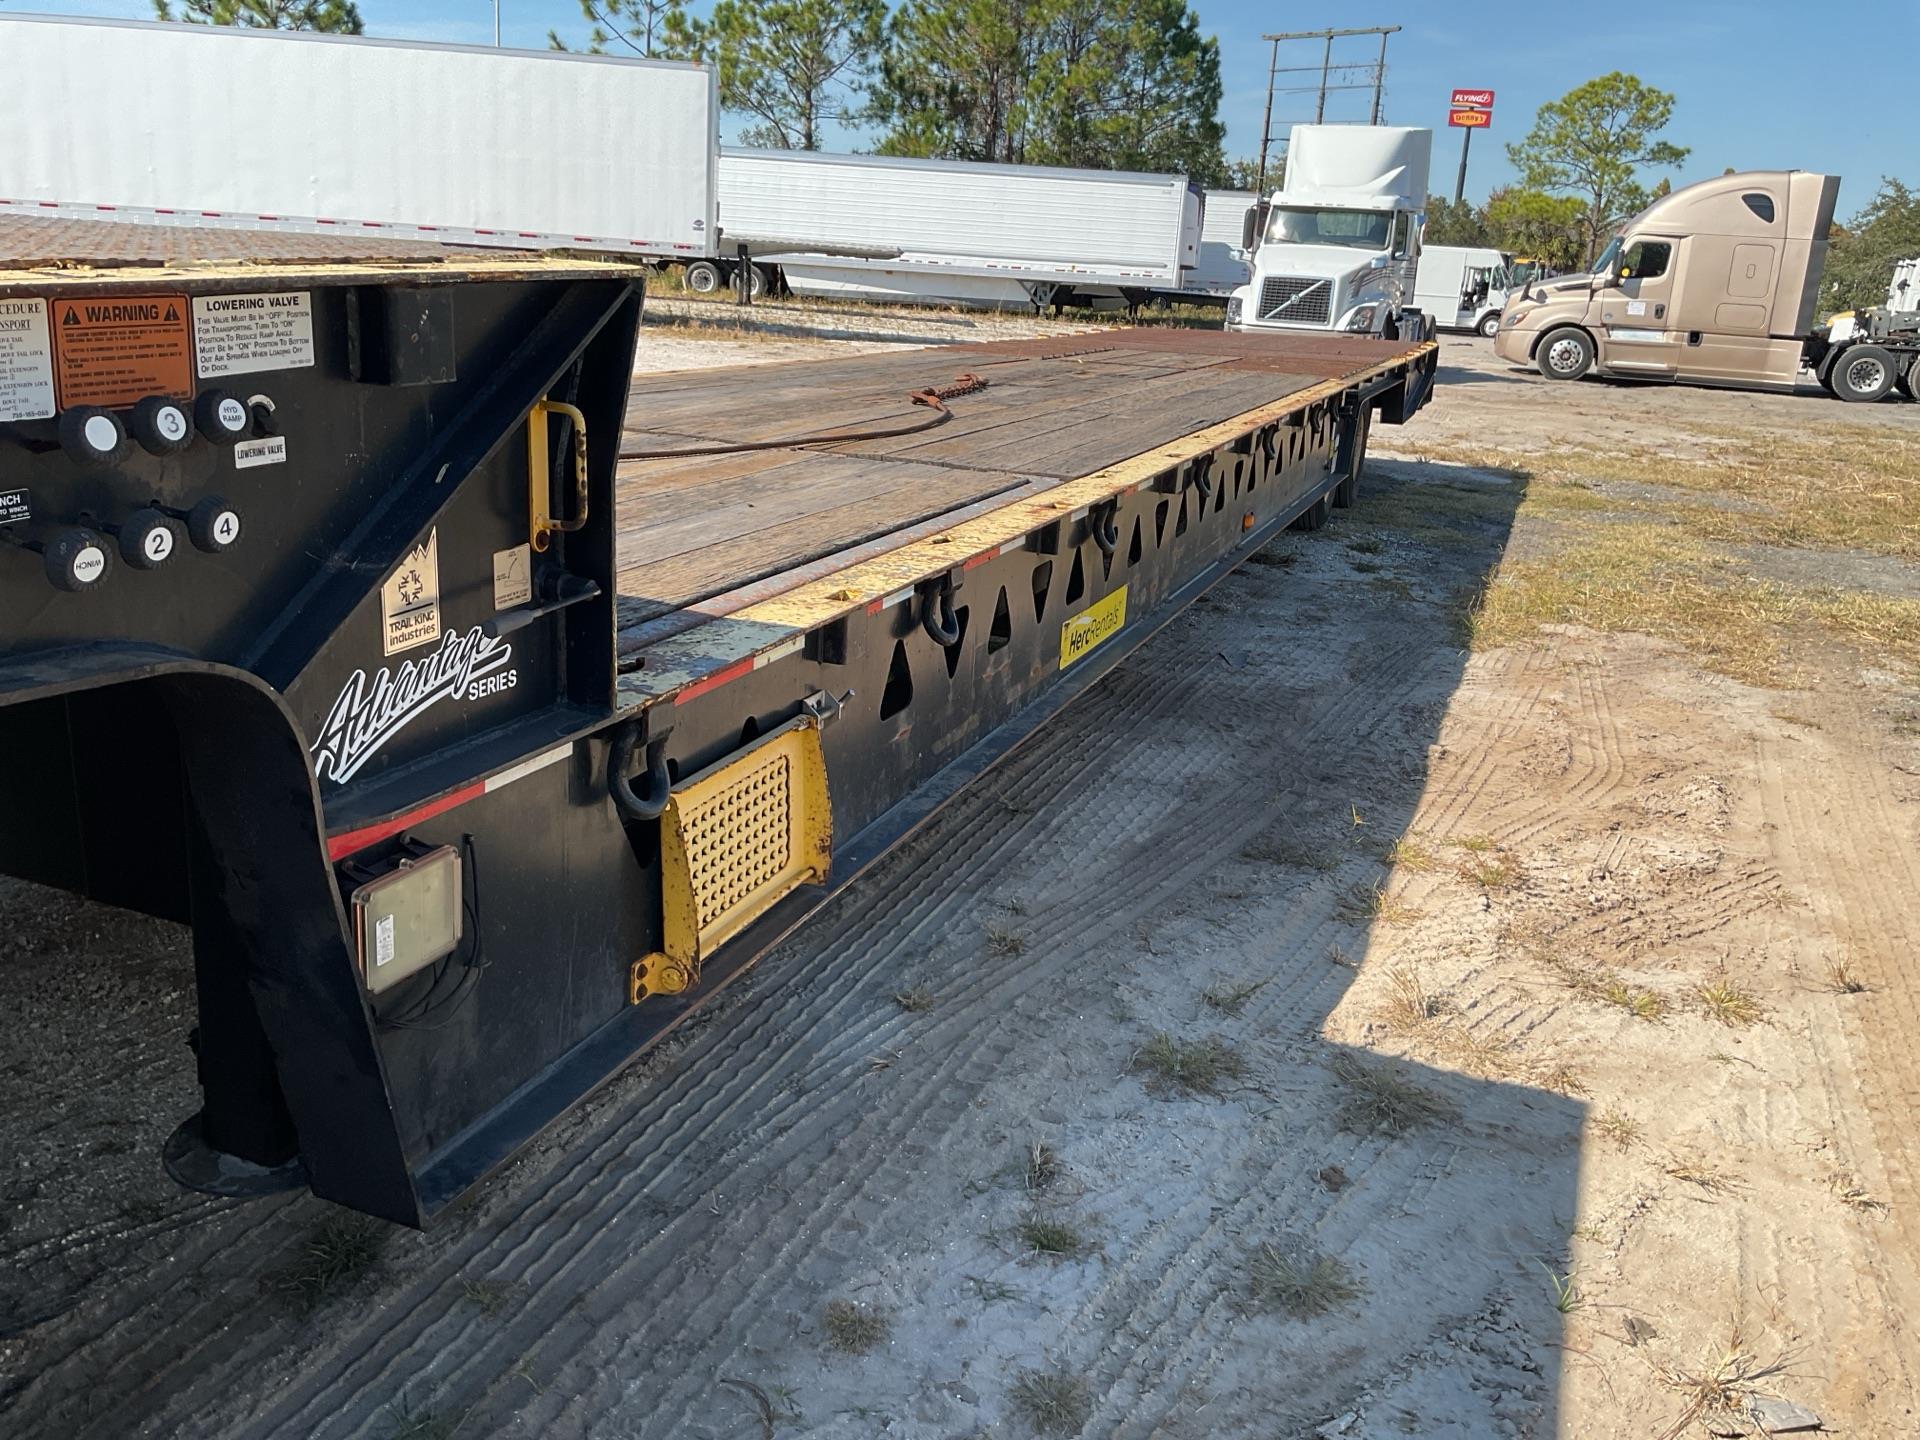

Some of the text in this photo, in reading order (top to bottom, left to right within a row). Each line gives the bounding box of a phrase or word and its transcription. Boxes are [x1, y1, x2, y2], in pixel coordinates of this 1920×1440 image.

[1455, 94, 1481, 102] FLYING
[85, 304, 160, 322] WARNING
[206, 296, 300, 312] LOWERING VALVE
[222, 414, 242, 422] RAMP
[223, 406, 238, 414] HYD
[164, 412, 180, 434] 3
[237, 444, 284, 460] LOWERING VALVE
[219, 517, 232, 537] 4
[151, 533, 165, 554] 2
[390, 623, 436, 646] industries
[468, 669, 518, 701] SERIES
